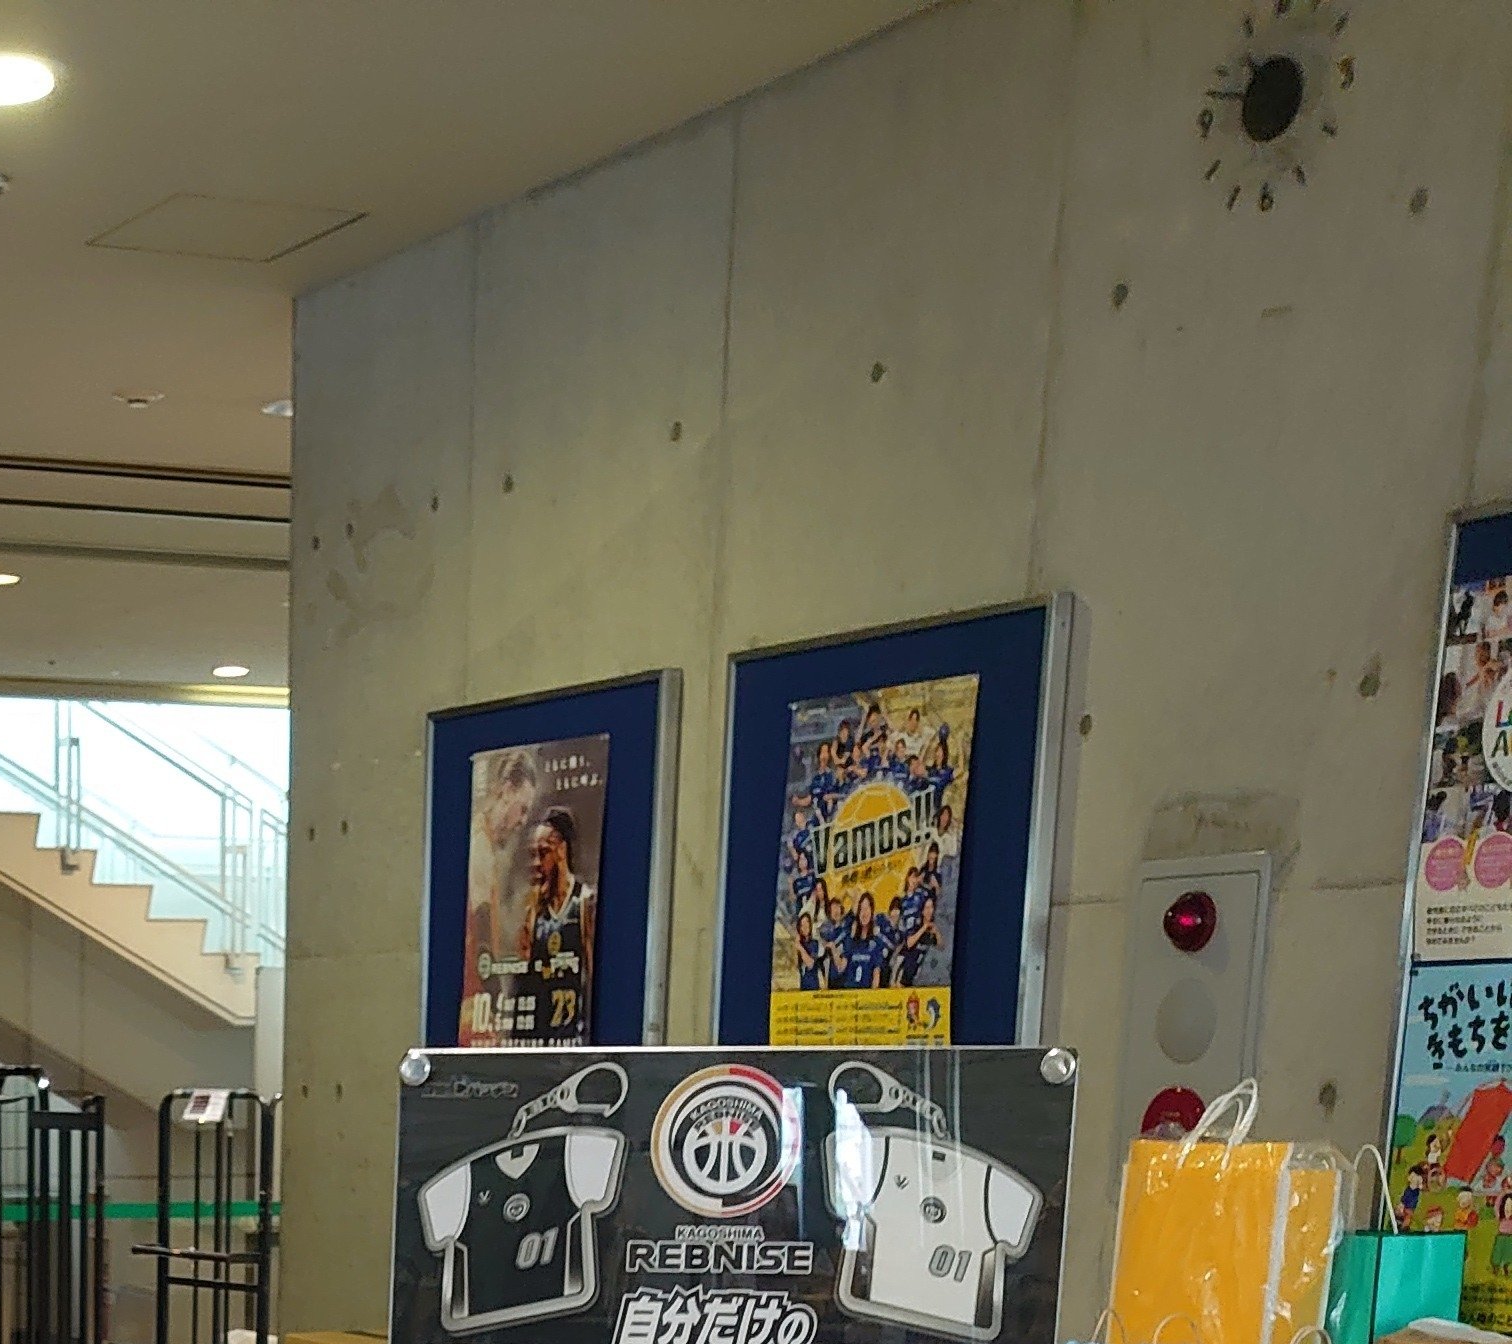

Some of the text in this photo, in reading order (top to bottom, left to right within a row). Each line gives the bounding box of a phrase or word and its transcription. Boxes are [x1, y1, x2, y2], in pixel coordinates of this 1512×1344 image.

[811, 789, 937, 876] Vamos!!
[515, 1226, 559, 1270] 01
[676, 1225, 764, 1241] KAGOSHIMA
[626, 1240, 813, 1275] REBNISE
[928, 1244, 972, 1282] 01
